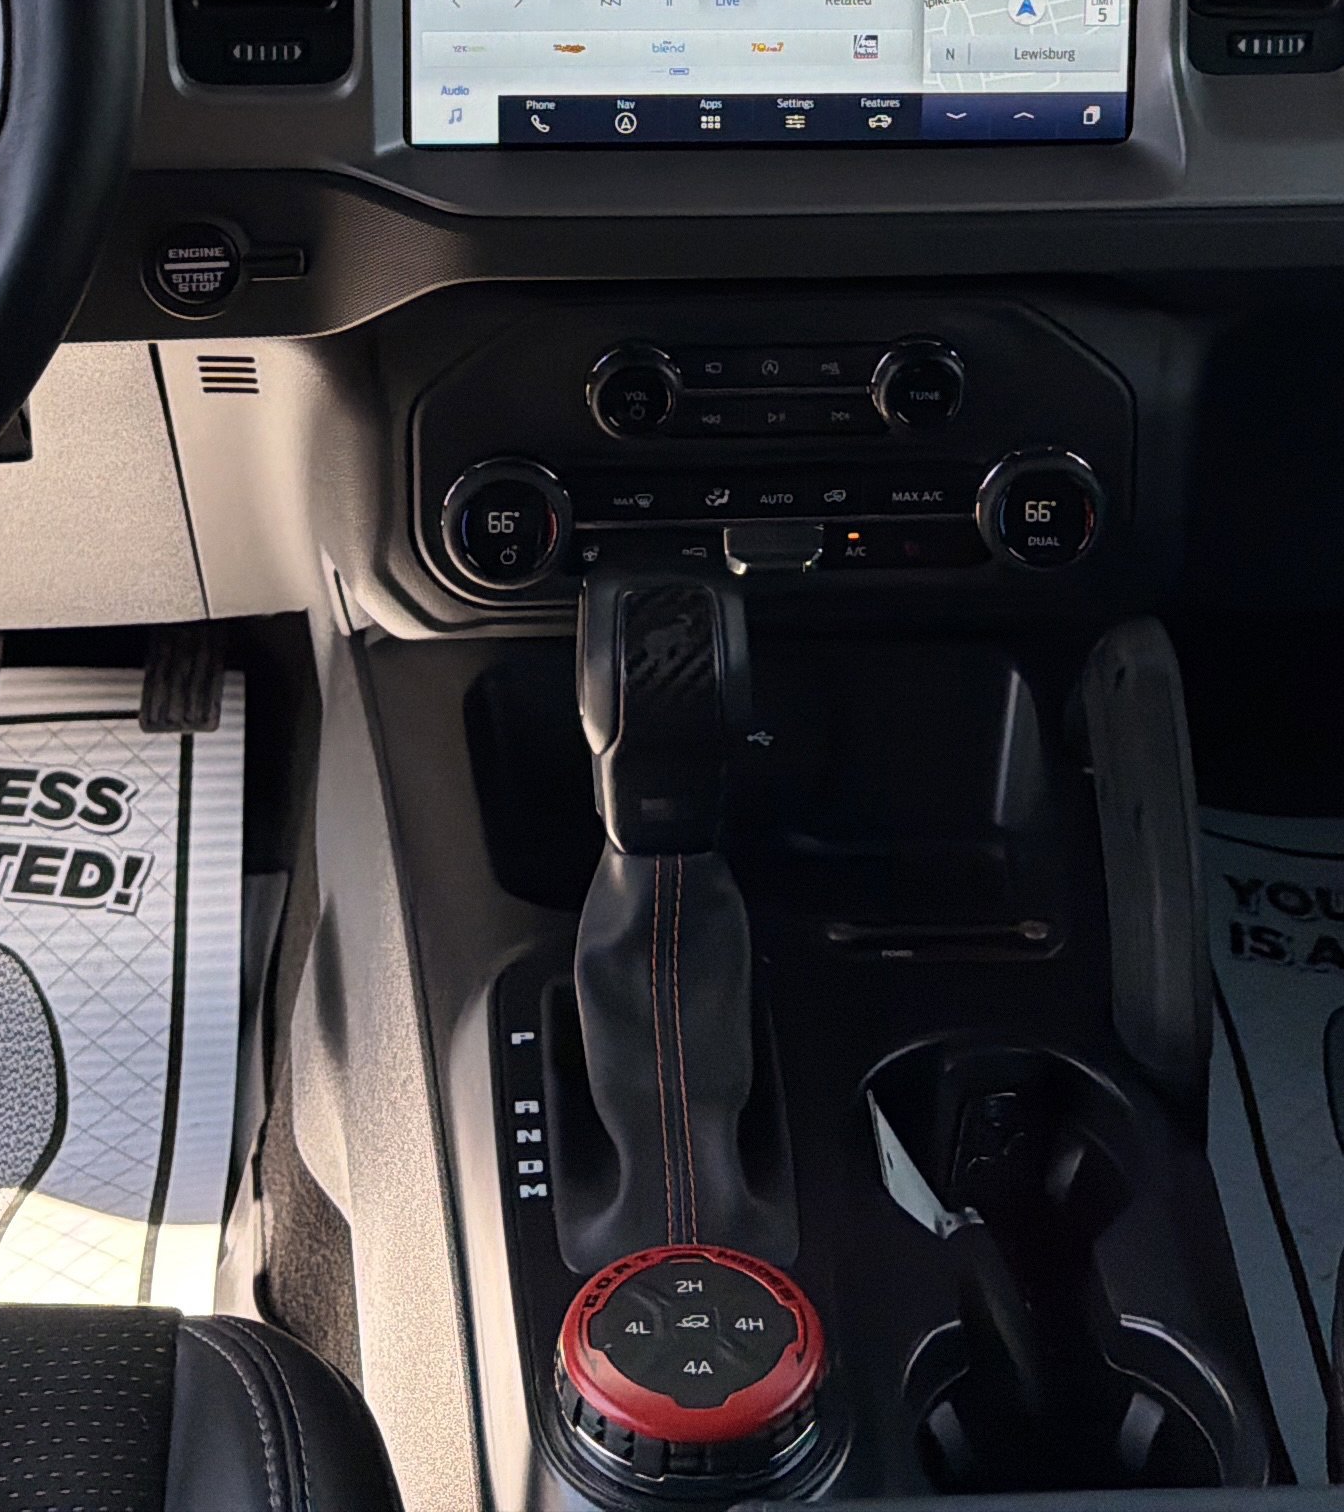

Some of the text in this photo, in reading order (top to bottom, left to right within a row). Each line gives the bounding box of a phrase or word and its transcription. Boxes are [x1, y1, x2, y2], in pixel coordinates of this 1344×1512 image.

[1097, 9, 1108, 23] 5
[652, 43, 685, 53] blend
[946, 48, 955, 60] N
[1014, 47, 1075, 62] Lewisburg
[441, 87, 469, 97] Audio
[527, 100, 555, 110] Phone
[617, 100, 635, 110] Nav
[700, 100, 722, 112] Apps
[777, 98, 814, 112] Settings
[861, 98, 900, 109] Features
[168, 247, 225, 258] ENGINE
[172, 272, 224, 283] START
[178, 282, 219, 292] STOP
[623, 391, 649, 401] VOL
[909, 391, 941, 401] TUNE
[760, 494, 793, 504] AUTO
[892, 490, 944, 502] MAX A/C
[1028, 536, 1060, 547] DUAL
[845, 545, 866, 557] A/C
[1229, 921, 1288, 961] IS
[512, 1032, 534, 1044] P
[517, 1129, 542, 1142] N
[518, 1160, 544, 1173] D
[520, 1184, 547, 1197] M
[675, 1280, 703, 1293] 2H
[624, 1321, 651, 1334] 4L
[734, 1317, 764, 1331] 4H
[682, 1360, 713, 1375] 4A
